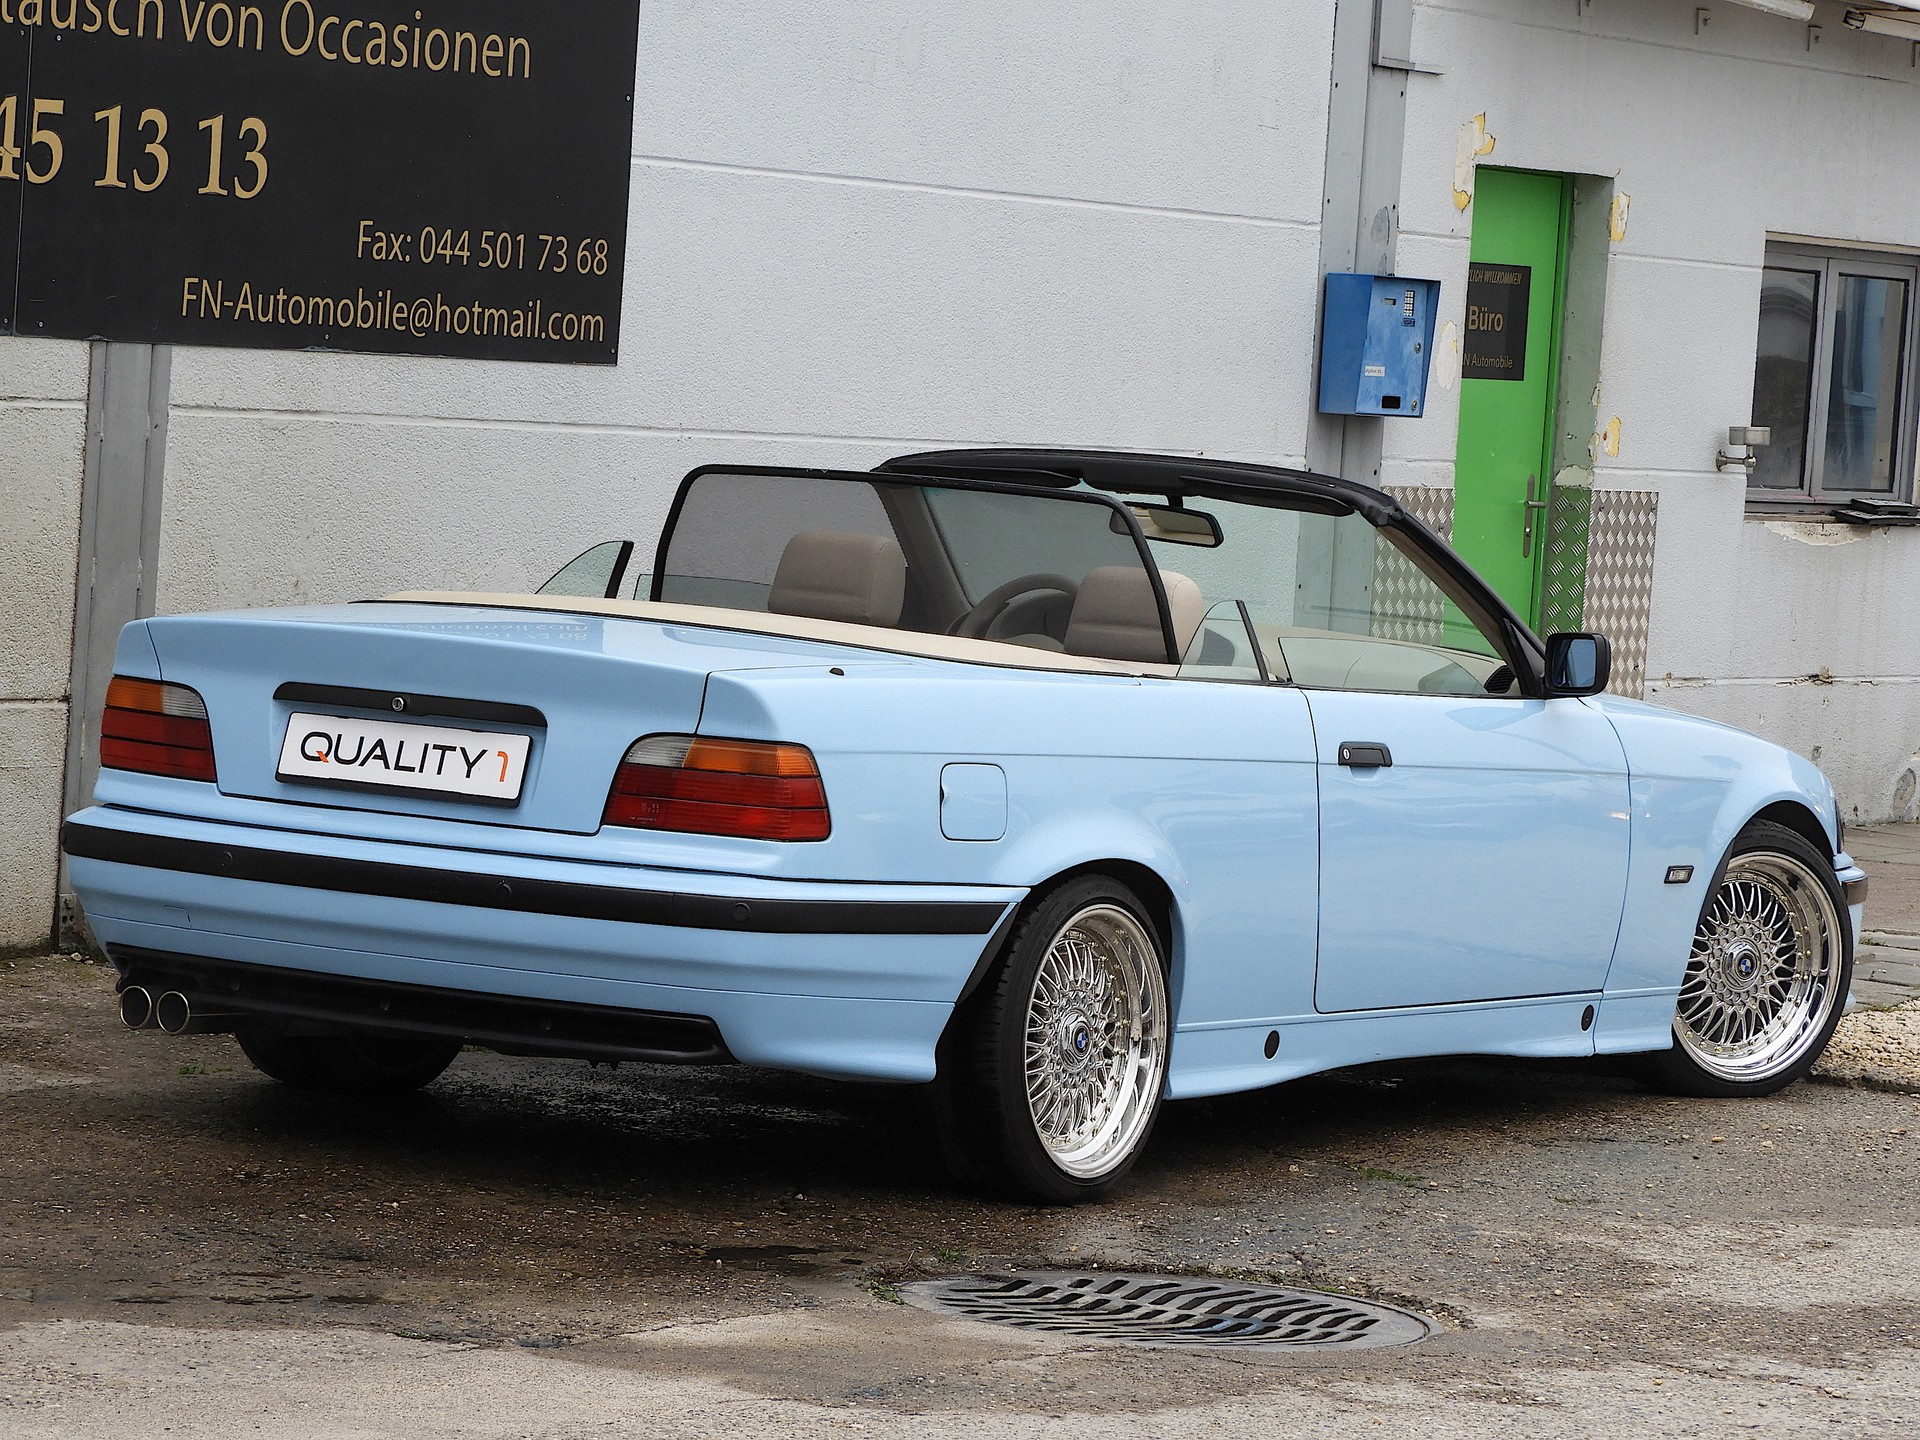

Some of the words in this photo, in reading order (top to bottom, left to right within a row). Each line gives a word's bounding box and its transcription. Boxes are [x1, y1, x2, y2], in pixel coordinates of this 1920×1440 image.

[178, 0, 264, 51] von
[280, 0, 532, 79] Occasionen
[94, 103, 170, 192] 13
[198, 113, 269, 199] 13
[357, 220, 412, 263] Fax:
[419, 226, 471, 266] 044
[478, 230, 526, 270] 501
[537, 234, 569, 273] 73
[576, 238, 609, 276] 68
[181, 277, 605, 342] FN-Automobile@hotmail.com
[1468, 305, 1504, 332] Büro
[1463, 352, 1471, 367] N
[1471, 353, 1513, 369] Automobile
[300, 731, 489, 779] QUALITY
